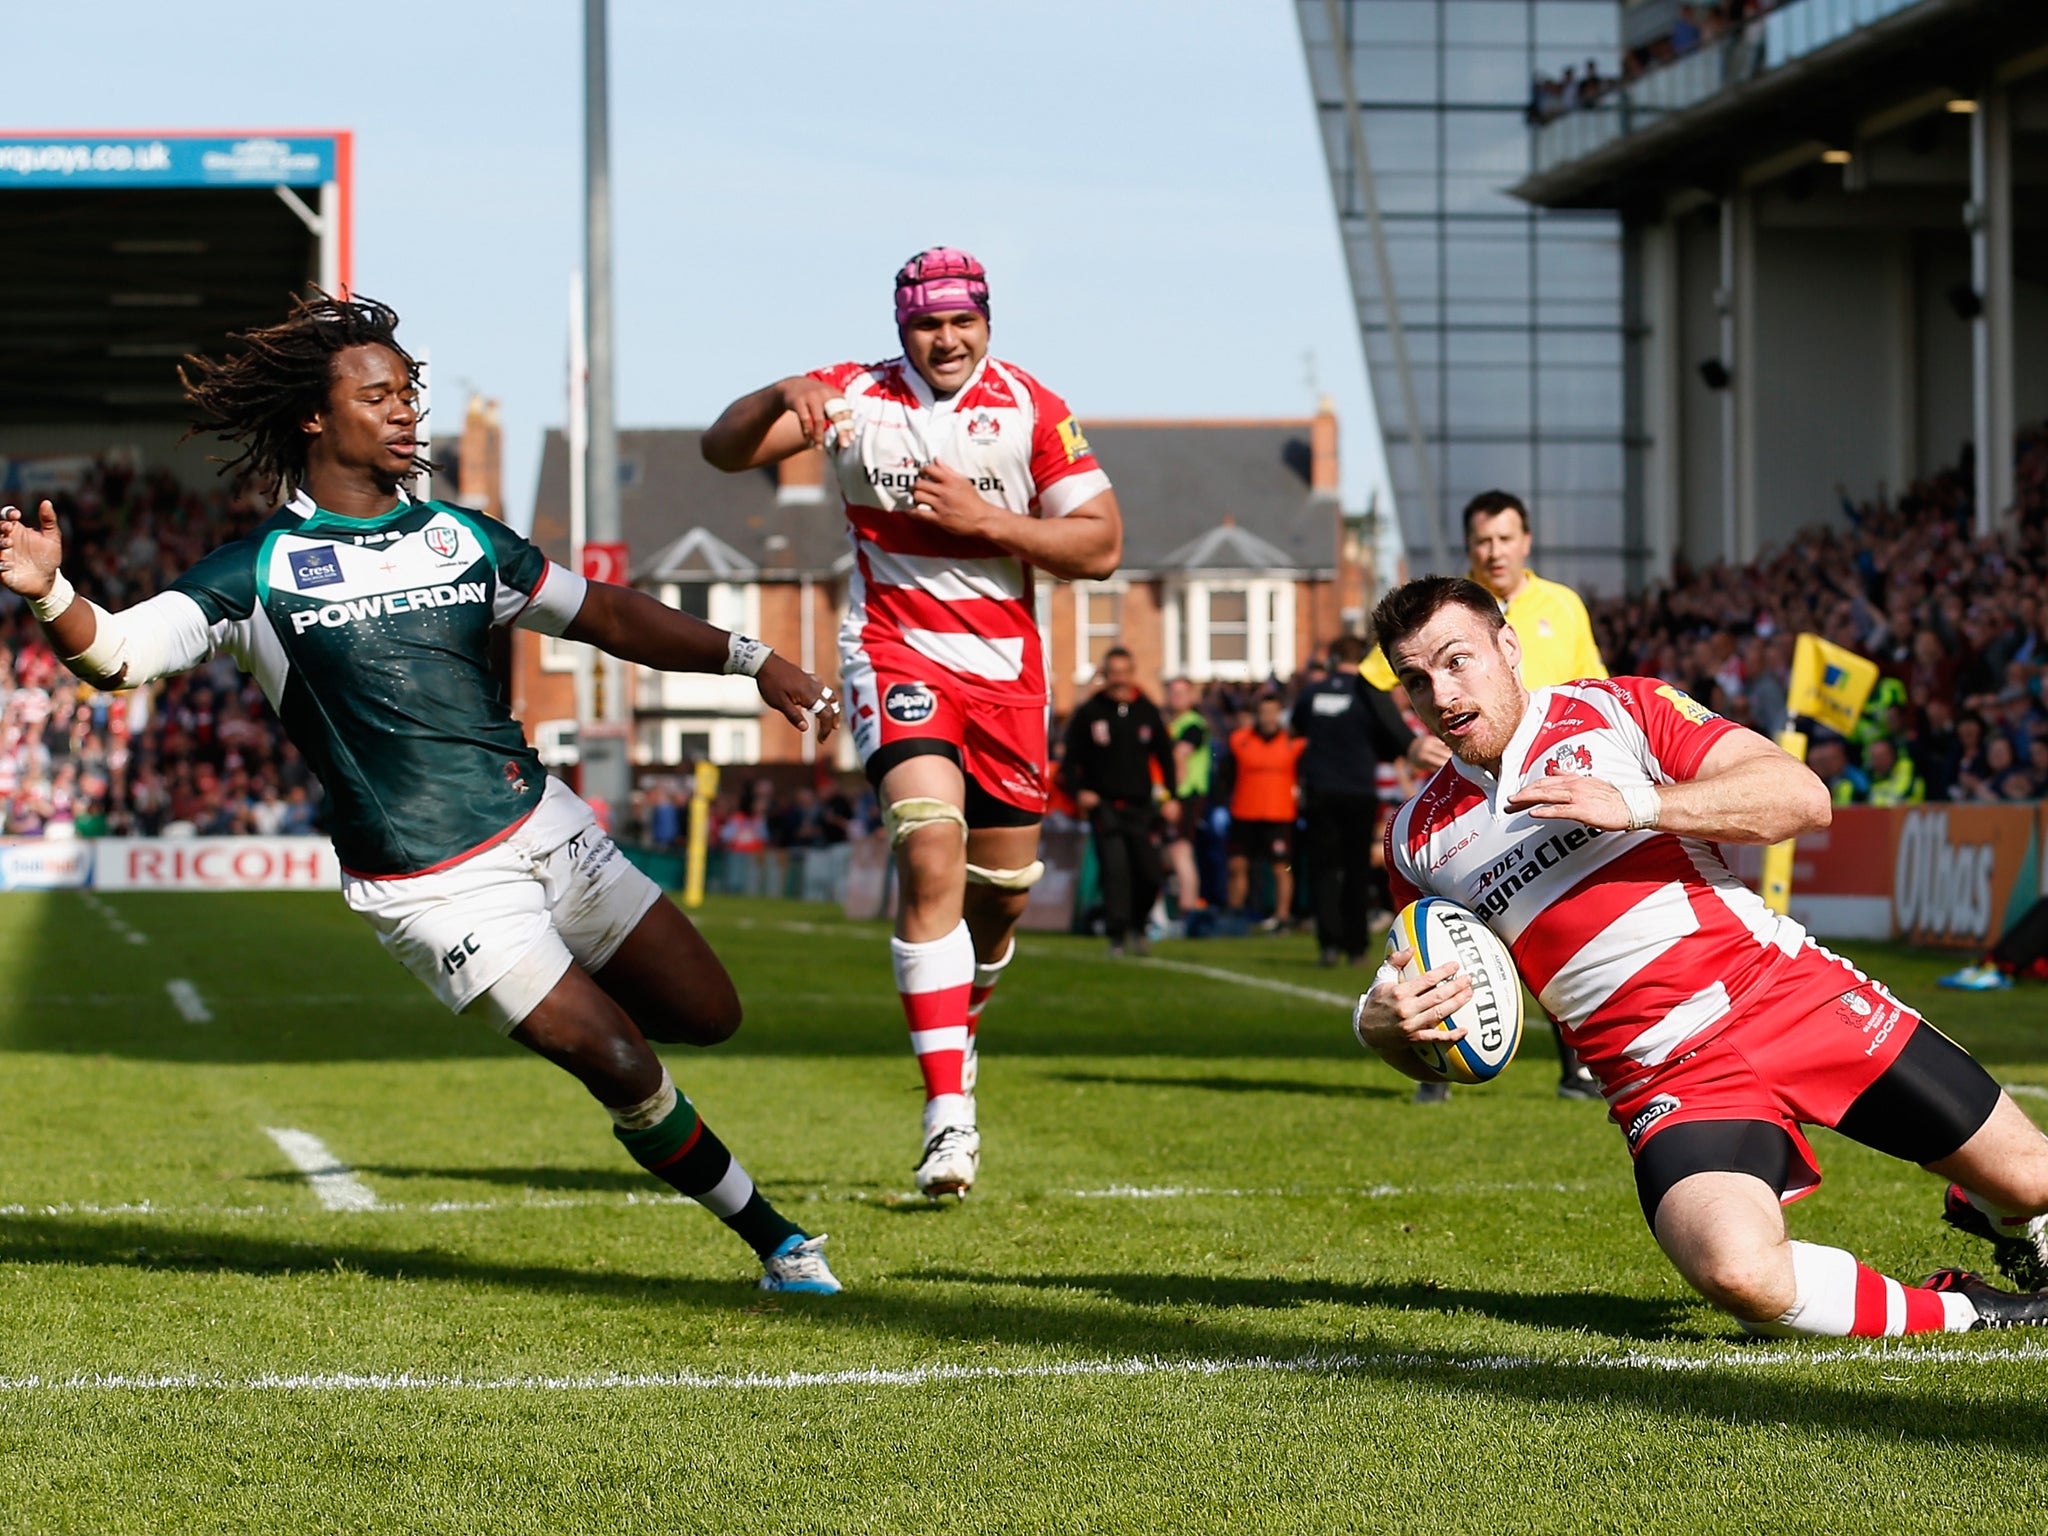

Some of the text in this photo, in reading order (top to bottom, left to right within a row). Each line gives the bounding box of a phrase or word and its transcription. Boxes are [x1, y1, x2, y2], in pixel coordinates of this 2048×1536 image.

[299, 563, 336, 577] Crest
[290, 582, 486, 635] POWERDAY
[128, 847, 319, 883] RICOH
[1430, 830, 1479, 873] KOOGA
[1475, 824, 1606, 922] agnaClea
[1478, 843, 1525, 893] ADEY
[1895, 809, 1994, 939] Olbas
[442, 932, 481, 975] ISC
[1436, 912, 1503, 1052] GILBERT
[1864, 1007, 1902, 1056] KOOGA
